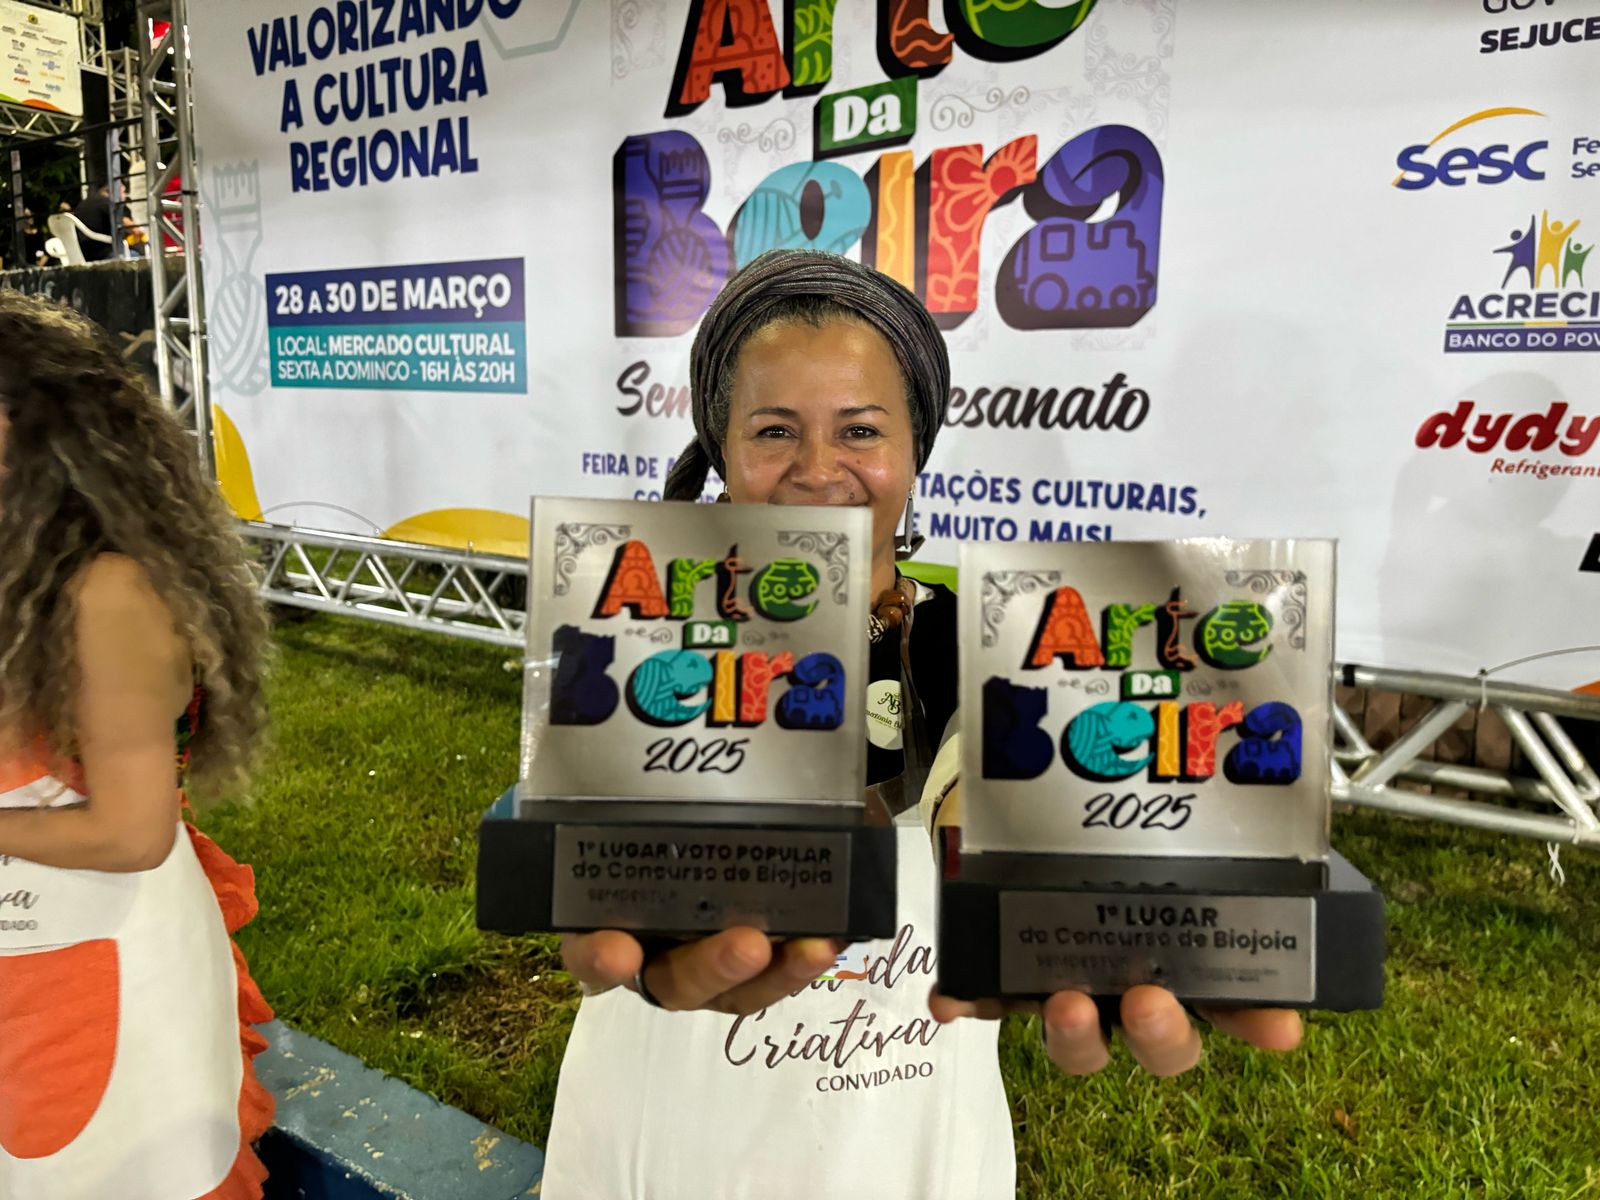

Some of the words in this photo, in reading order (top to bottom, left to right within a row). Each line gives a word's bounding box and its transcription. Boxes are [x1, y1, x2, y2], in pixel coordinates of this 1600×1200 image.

[280, 79, 304, 133] A
[313, 39, 489, 126] CULTURA
[832, 93, 901, 142] Da
[289, 115, 479, 193] REGIONAL
[275, 284, 304, 315] 28
[307, 290, 323, 314] A
[325, 282, 357, 313] 30
[361, 279, 398, 312] DE
[403, 273, 512, 318] MARÇO
[277, 335, 326, 356] LOCAL:
[328, 334, 413, 356] MERCADO
[415, 333, 516, 356] CULTURAL
[1450, 333, 1520, 348] BANCO
[1527, 332, 1557, 347] DO
[278, 360, 320, 380] SEXTA
[322, 361, 334, 380] A
[335, 360, 410, 382] DOMINGO
[419, 360, 450, 382] 16H
[452, 355, 476, 383] ÀS
[479, 361, 516, 384] 20H
[616, 360, 692, 419] Sem
[945, 372, 1151, 432] esanato
[582, 452, 629, 476] FEIRA
[636, 456, 659, 478] DE
[918, 469, 1021, 505] TAÇÕES
[1032, 479, 1206, 519] CULTURAIS,
[930, 513, 1017, 542] MUITO
[591, 540, 820, 621] Arte
[692, 622, 730, 644] Da
[1021, 583, 1274, 671] Arte
[550, 624, 846, 731] Beira
[1130, 672, 1173, 696] Da
[982, 675, 1303, 785] Beira
[643, 738, 750, 774] 2025
[1082, 793, 1197, 831] 2025
[601, 842, 667, 859] LUGAR
[676, 842, 731, 861] VOTO
[737, 844, 832, 864] POPULAR
[572, 861, 601, 879] do
[608, 861, 717, 881] Concurso
[723, 865, 750, 882] de
[757, 865, 833, 889] Biojoia
[1126, 906, 1218, 927] LUGAR
[1019, 926, 1048, 944] do
[1055, 926, 1171, 948] Concurso
[1178, 929, 1206, 948] de
[1213, 931, 1297, 956] Biojoia
[725, 999, 941, 1069] Criativa
[816, 1061, 934, 1093] CONVIDADO
